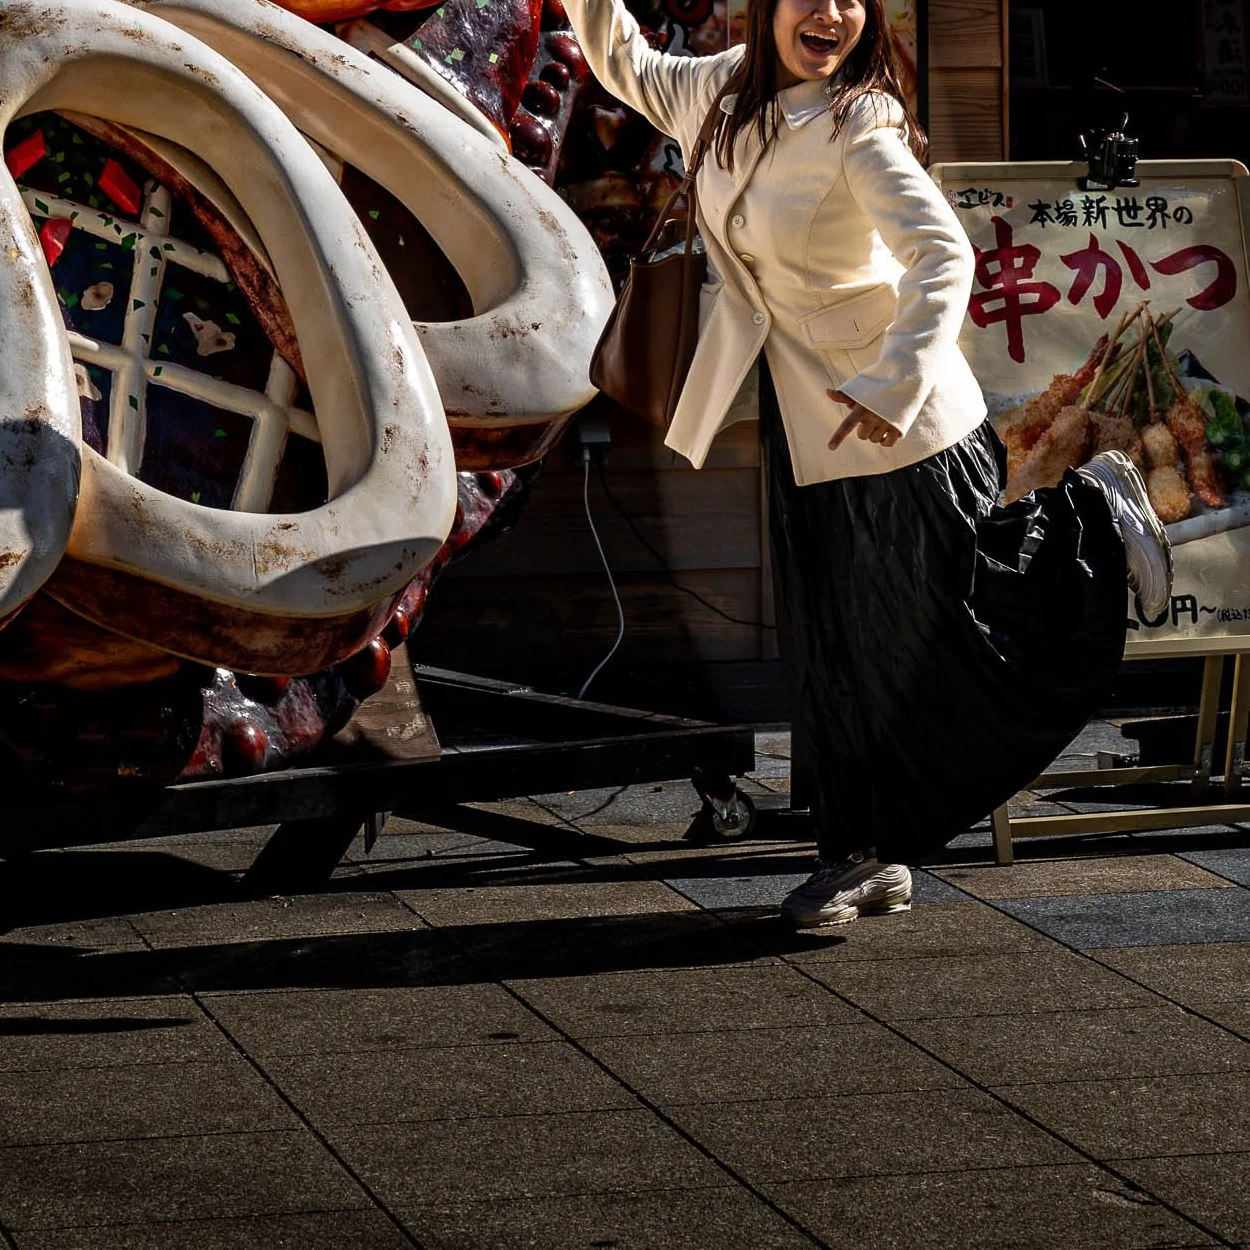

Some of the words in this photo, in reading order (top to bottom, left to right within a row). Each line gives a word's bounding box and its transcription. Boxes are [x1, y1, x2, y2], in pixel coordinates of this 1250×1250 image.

[1028, 195, 1194, 230] 本場新世界の
[969, 216, 1237, 364] 串かつ
